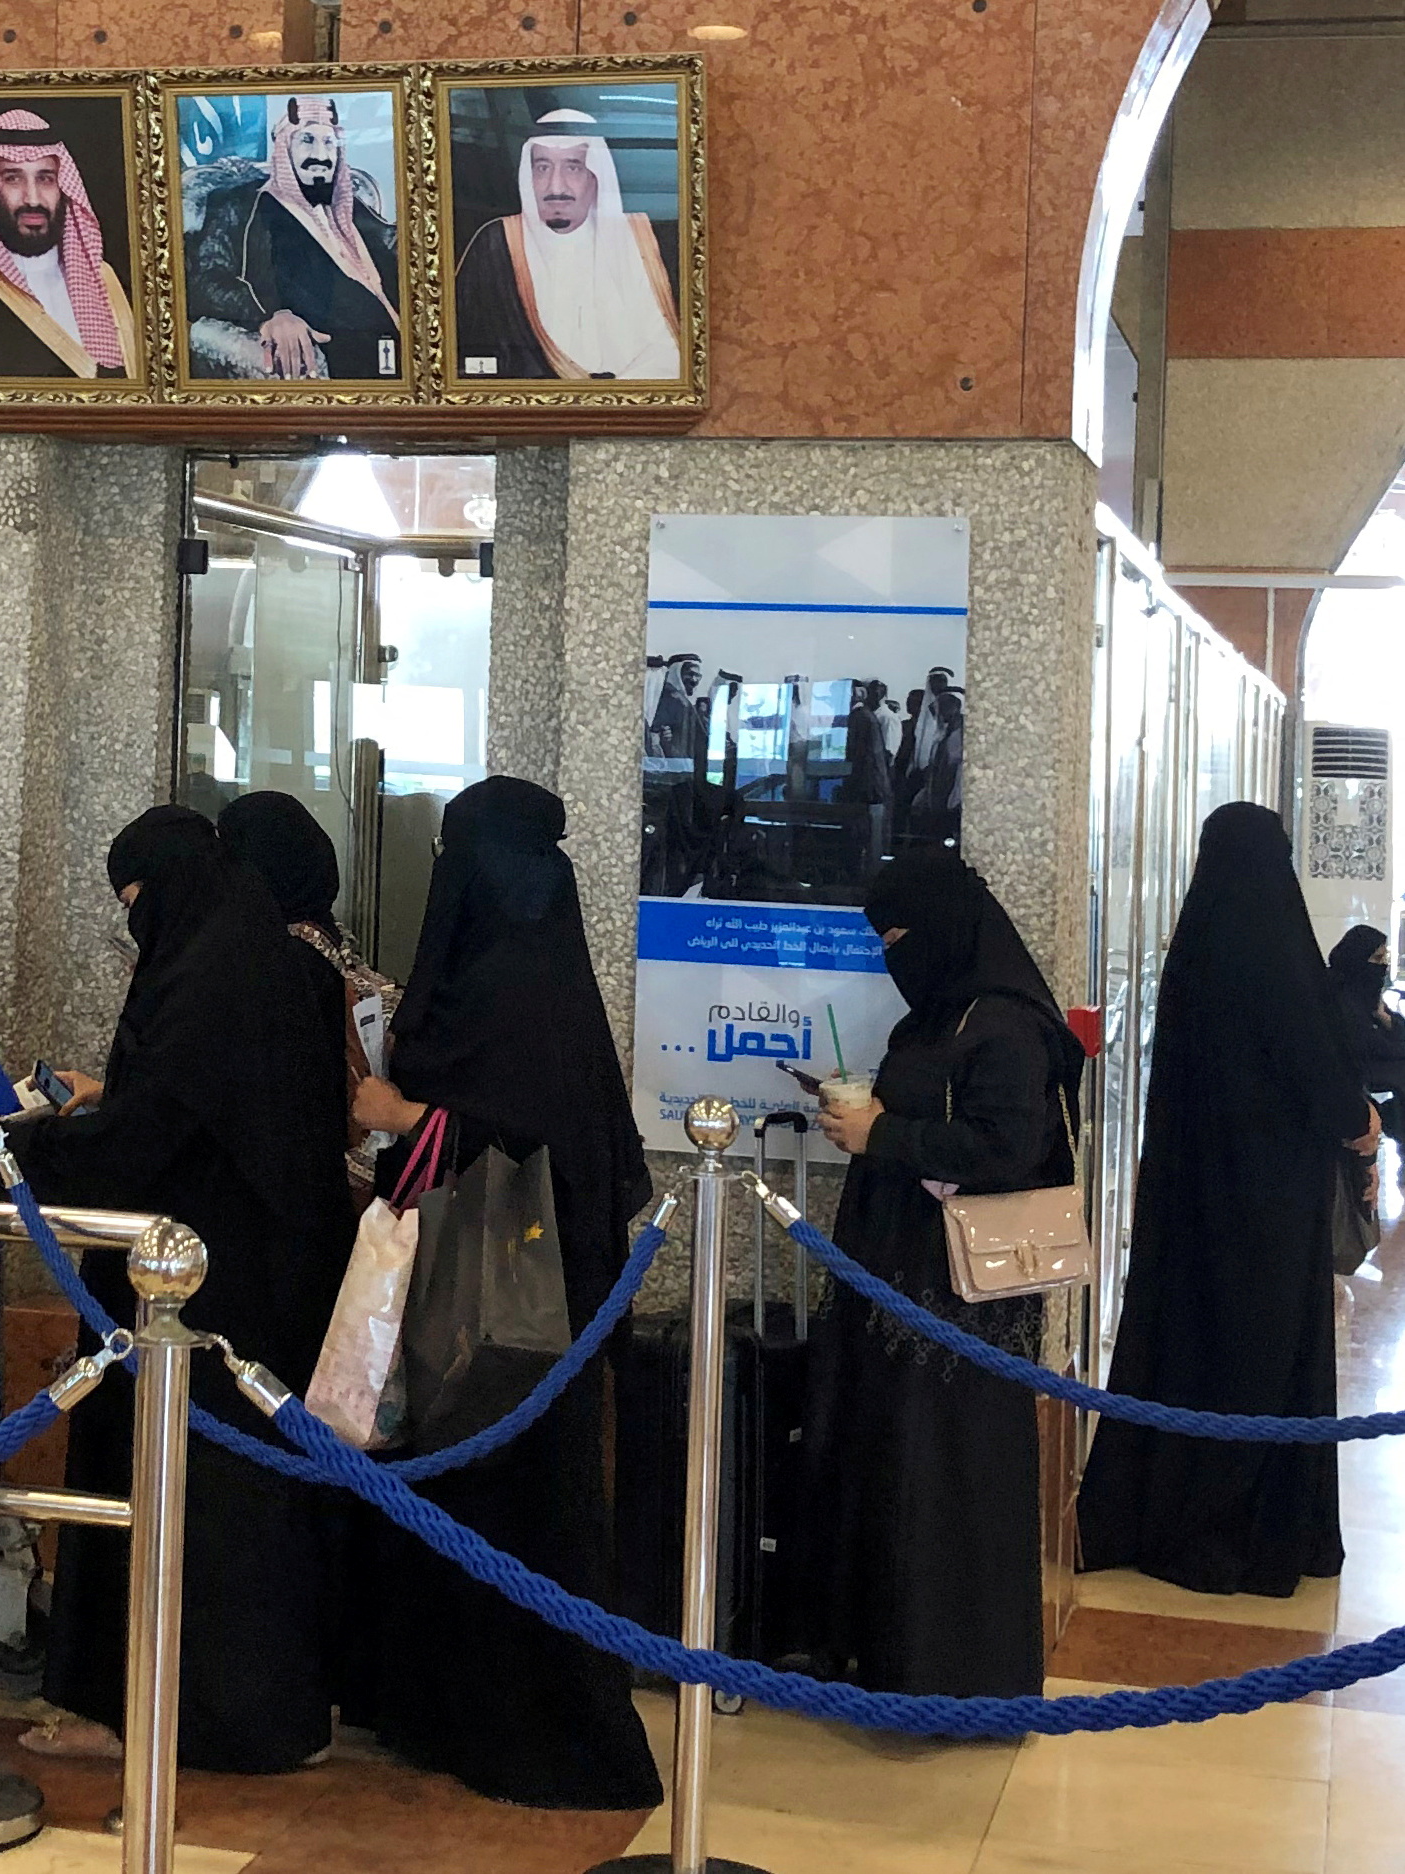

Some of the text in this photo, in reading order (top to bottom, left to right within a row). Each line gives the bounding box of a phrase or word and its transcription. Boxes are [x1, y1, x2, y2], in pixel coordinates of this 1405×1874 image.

[705, 917, 723, 930] ثراه
[725, 918, 742, 929] الله
[744, 920, 768, 933] طيب
[771, 920, 811, 934] عبدالعزيز
[813, 926, 825, 936] بن
[828, 927, 856, 938] سعود
[687, 935, 718, 948] الرياض
[741, 939, 780, 952] الحديدي
[783, 939, 806, 951] الخط
[708, 1001, 800, 1028] والقادم
[730, 1096, 756, 1109] للخط
[659, 1109, 683, 1121] SAU
